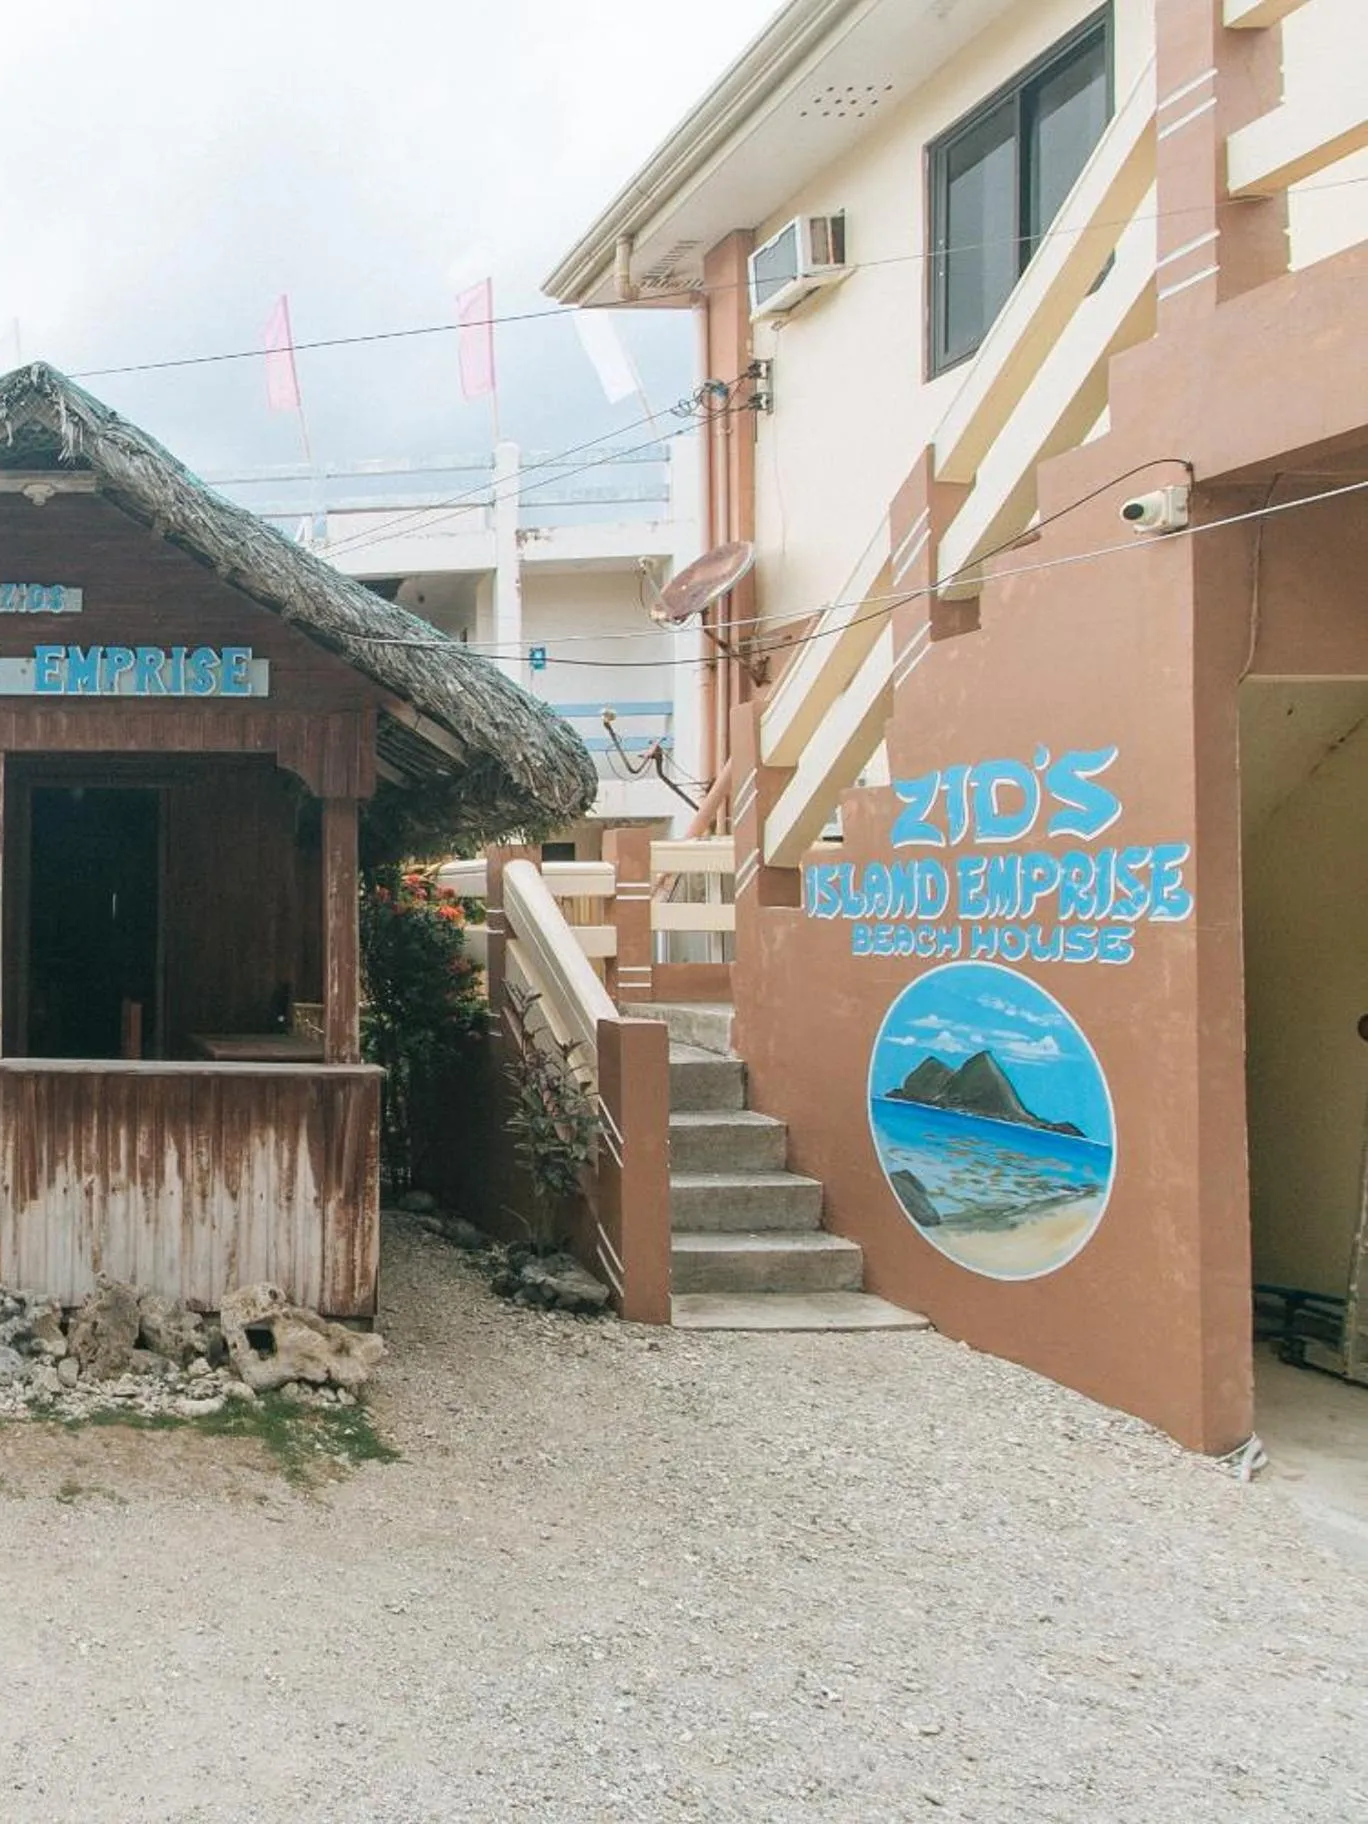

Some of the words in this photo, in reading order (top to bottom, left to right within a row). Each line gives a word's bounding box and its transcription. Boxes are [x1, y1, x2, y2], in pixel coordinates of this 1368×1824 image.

[33, 646, 252, 696] EMPRISE
[890, 745, 1122, 848] ZID'S
[806, 859, 949, 920] ISLAND
[957, 844, 1194, 923] EMPRISE
[851, 922, 963, 957] BEACH
[970, 925, 1136, 965] HOUSE
